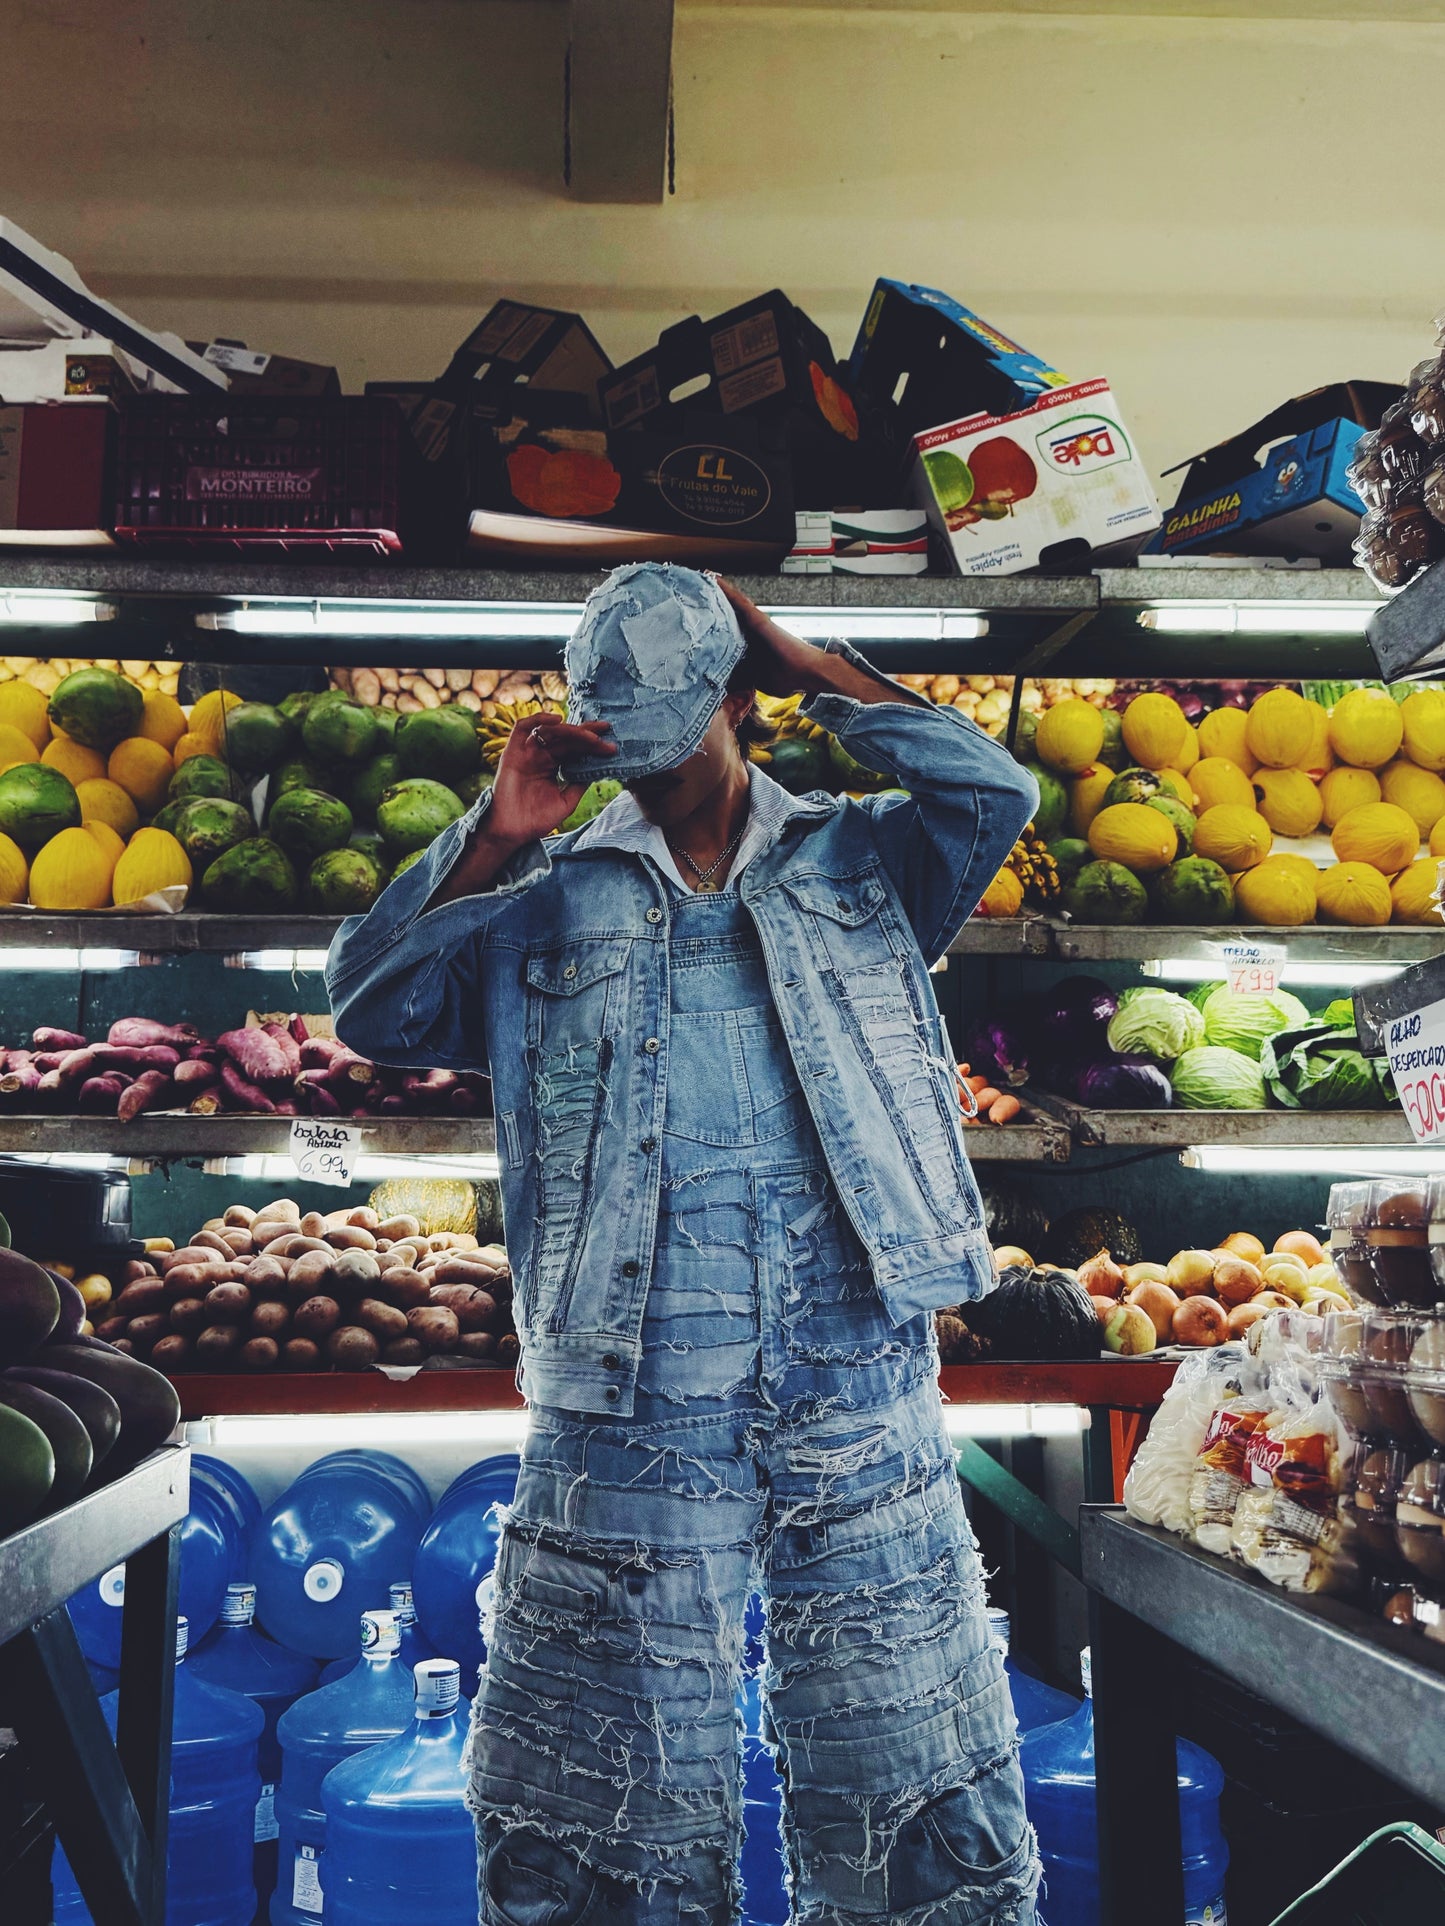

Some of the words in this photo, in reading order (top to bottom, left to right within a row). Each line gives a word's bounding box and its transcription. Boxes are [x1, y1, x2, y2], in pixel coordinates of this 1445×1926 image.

[1053, 432, 1115, 466] Dole
[201, 479, 311, 493] MONTEIRO
[669, 477, 709, 492] Frutas
[713, 483, 728, 493] do
[732, 484, 758, 497] Vale
[1166, 492, 1241, 535] GALINHA
[970, 555, 1003, 572] Apples
[1231, 968, 1275, 993] 7,99
[1390, 1014, 1421, 1049] ALHO
[1390, 1045, 1445, 1074] DESPENCADO
[294, 1122, 351, 1141] batata
